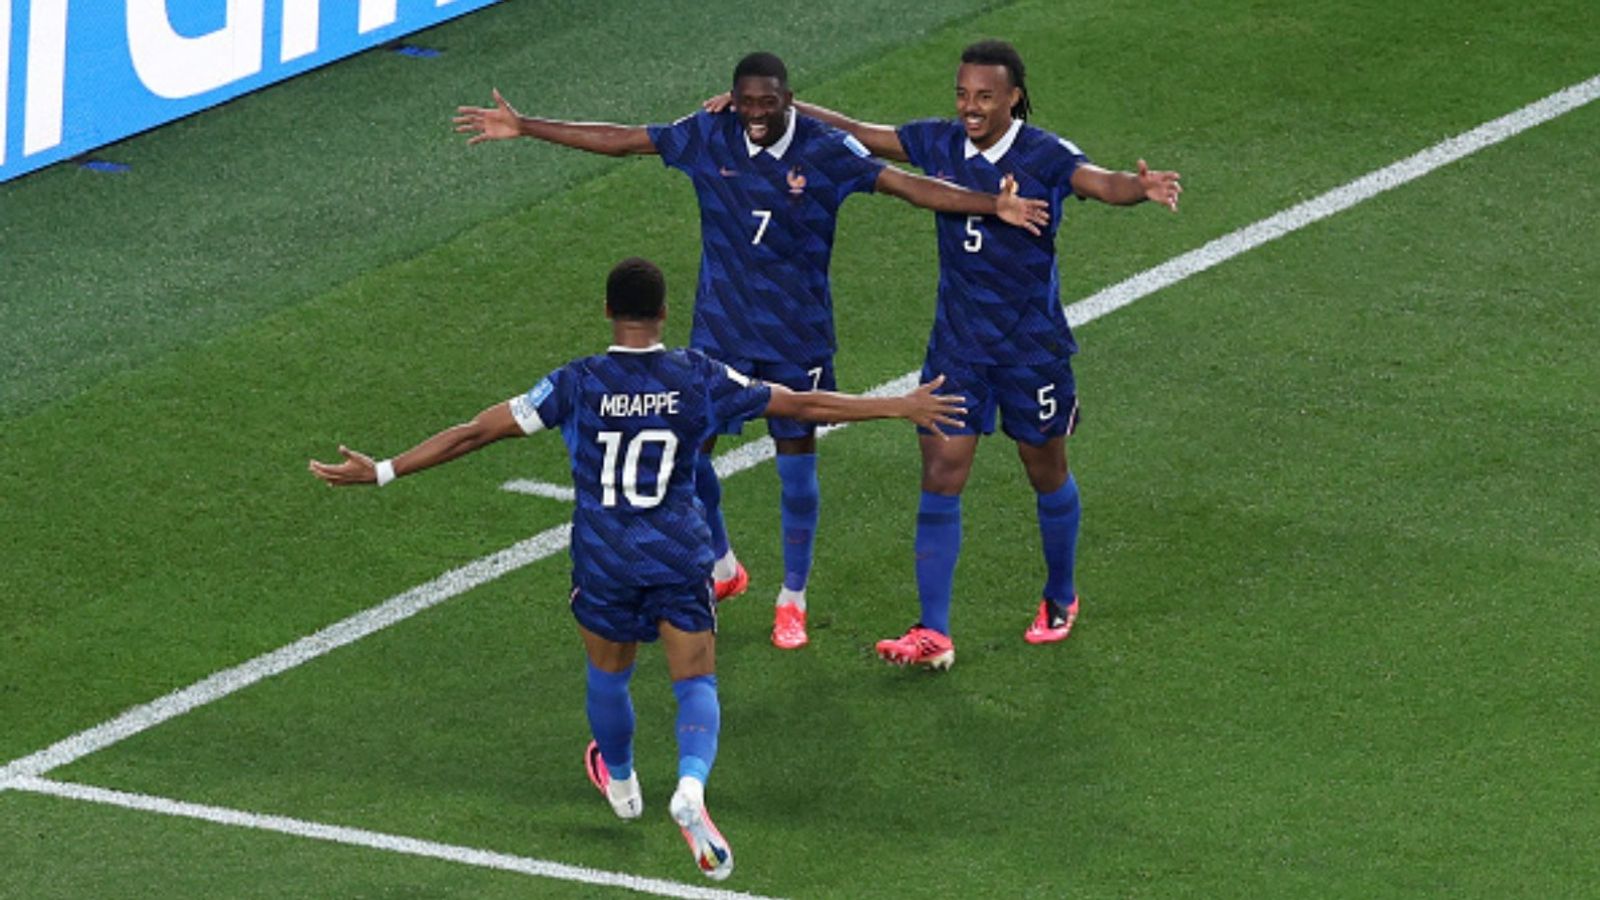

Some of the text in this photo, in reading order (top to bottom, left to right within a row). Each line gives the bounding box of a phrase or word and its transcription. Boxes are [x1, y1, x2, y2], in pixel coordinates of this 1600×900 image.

[751, 210, 772, 245] 7
[964, 215, 982, 252] 5
[807, 366, 822, 392] 7
[600, 391, 680, 417] MBAPPE
[1037, 383, 1057, 420] 5
[597, 429, 679, 509] 10
